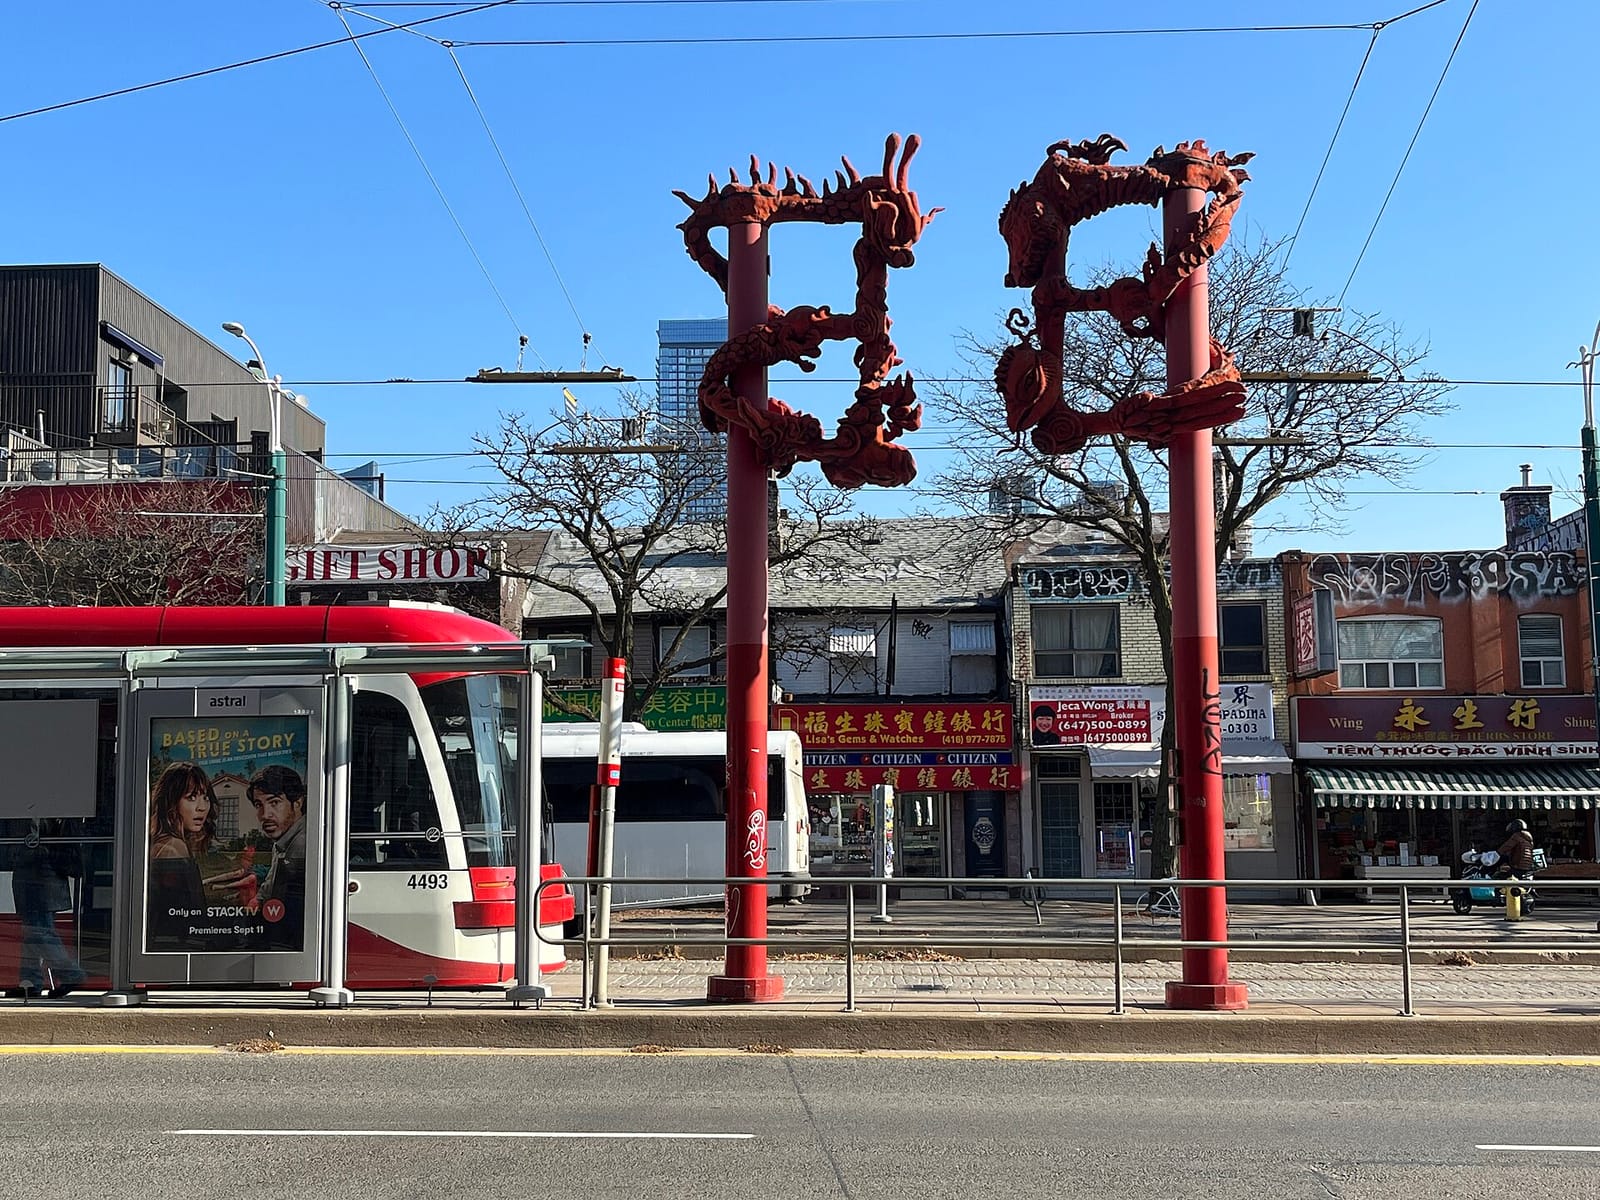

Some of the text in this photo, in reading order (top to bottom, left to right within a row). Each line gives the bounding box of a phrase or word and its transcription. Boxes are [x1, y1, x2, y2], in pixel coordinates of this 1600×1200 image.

[209, 695, 246, 707] astral
[645, 689, 726, 714] 美容中
[1057, 701, 1080, 713] Jeca
[1081, 701, 1115, 712] Wong
[1394, 698, 1541, 731] 永生行
[658, 717, 690, 727] Center
[691, 714, 726, 729] 416-597-
[1058, 720, 1148, 732] (647)500-0899
[1329, 716, 1597, 730] Wing Shing
[1219, 723, 1257, 733] -0303
[163, 728, 250, 747] BASED ON A
[806, 734, 835, 744] Lisa's
[838, 735, 866, 744] Gems
[870, 735, 877, 744] &
[880, 734, 924, 744] Watches
[942, 735, 964, 745] (416)
[1467, 731, 1554, 741] HERBS STORE
[188, 741, 231, 759] TRUE
[237, 732, 295, 753] STORY
[804, 753, 998, 765] ITIZEN CITIZEN CITIZEN
[407, 874, 448, 889] 4493
[168, 907, 189, 918] Only
[267, 905, 280, 917] W
[189, 925, 264, 935] Premieres Sept 11
